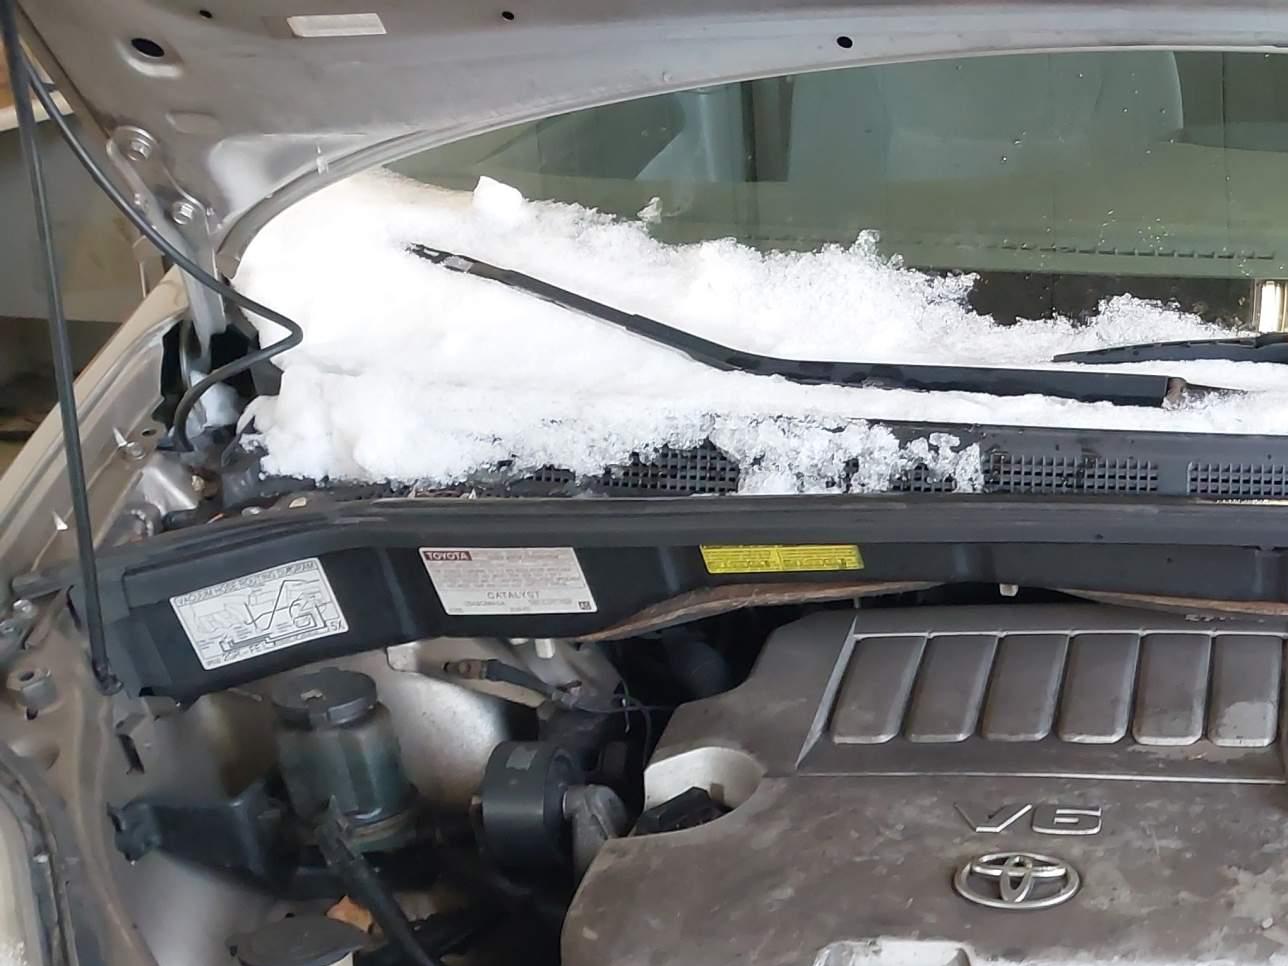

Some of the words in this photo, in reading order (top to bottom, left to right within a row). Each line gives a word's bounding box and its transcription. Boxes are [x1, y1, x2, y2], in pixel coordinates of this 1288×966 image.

[426, 551, 470, 560] TOYOTA
[487, 591, 540, 599] CATALYST
[953, 803, 1102, 835] V6
